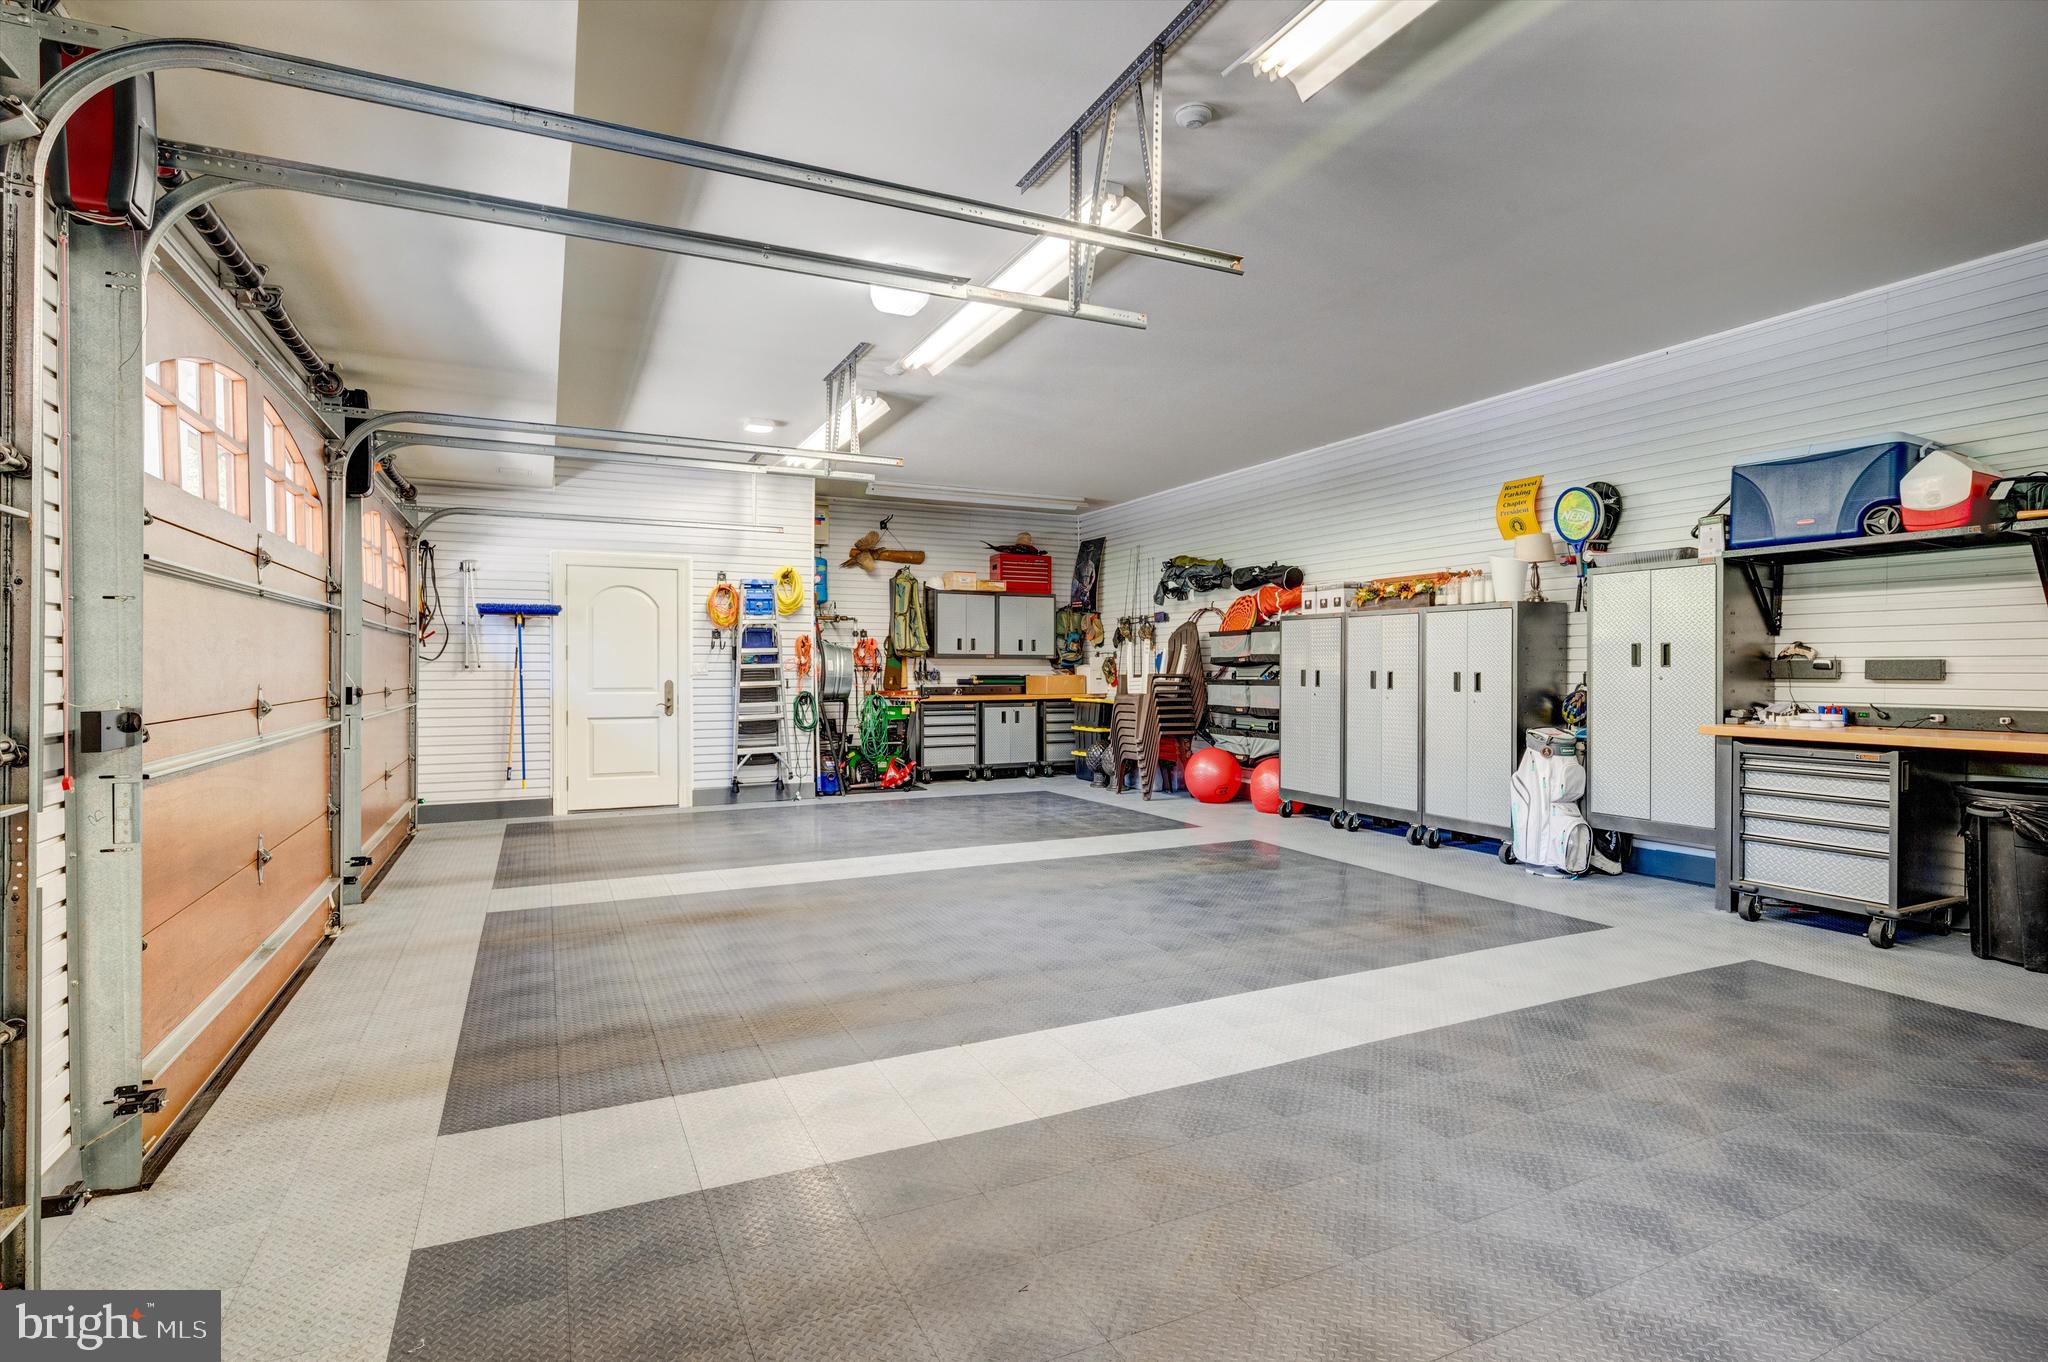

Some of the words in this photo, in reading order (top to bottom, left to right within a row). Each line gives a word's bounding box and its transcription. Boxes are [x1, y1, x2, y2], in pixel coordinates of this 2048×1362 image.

[1504, 480, 1537, 490] Reserved
[1503, 489, 1531, 498] Parking
[1502, 499, 1527, 508] Chapter
